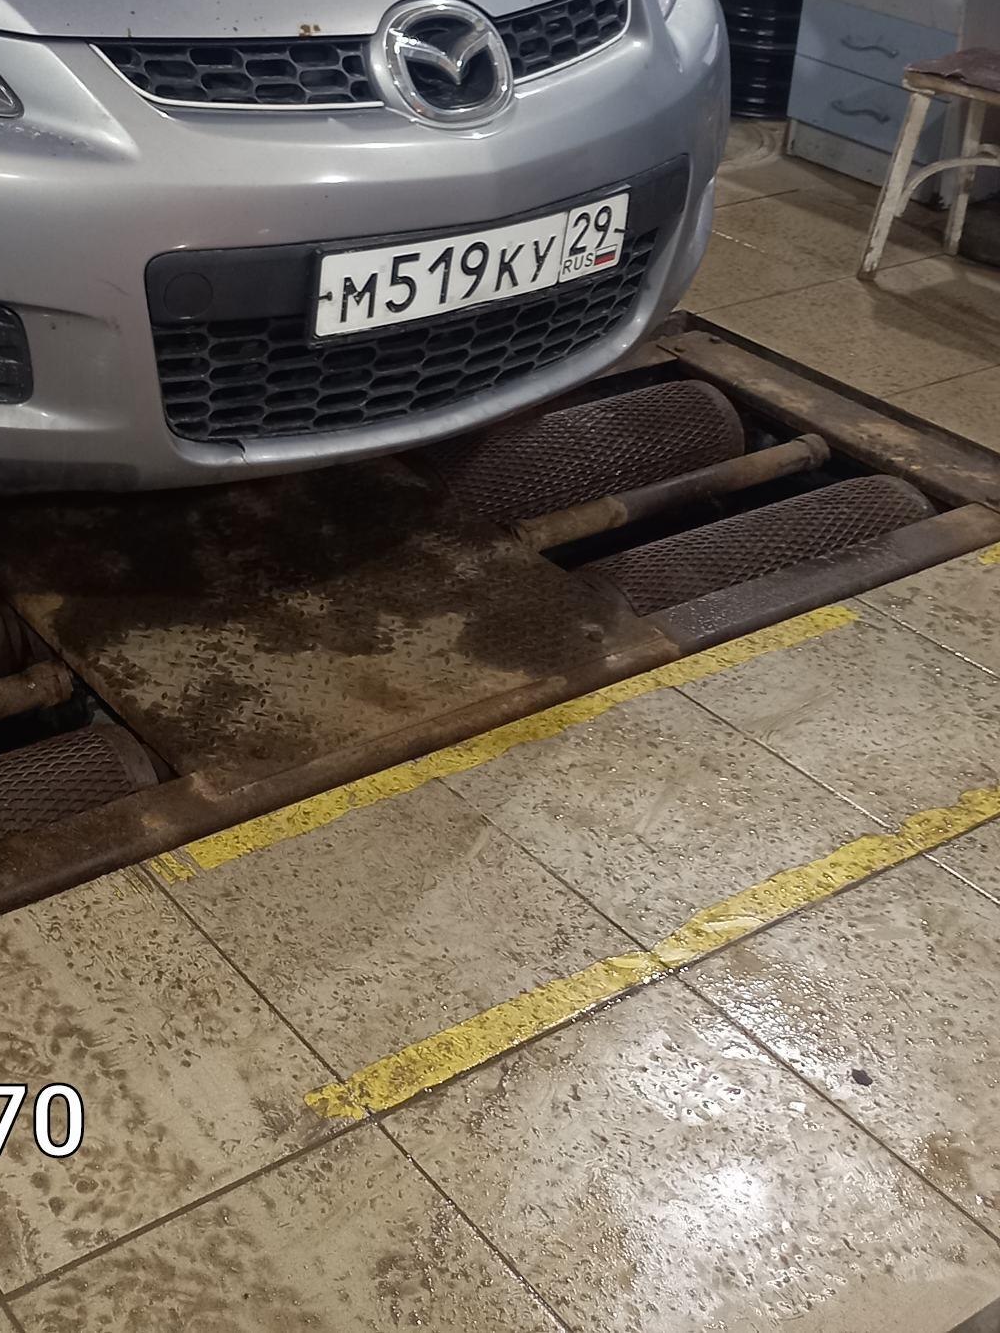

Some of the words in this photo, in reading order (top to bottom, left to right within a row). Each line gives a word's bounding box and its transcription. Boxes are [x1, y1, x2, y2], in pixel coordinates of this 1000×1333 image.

[339, 236, 556, 323] М519КУ
[569, 205, 612, 256] 29
[562, 252, 593, 276] RUS
